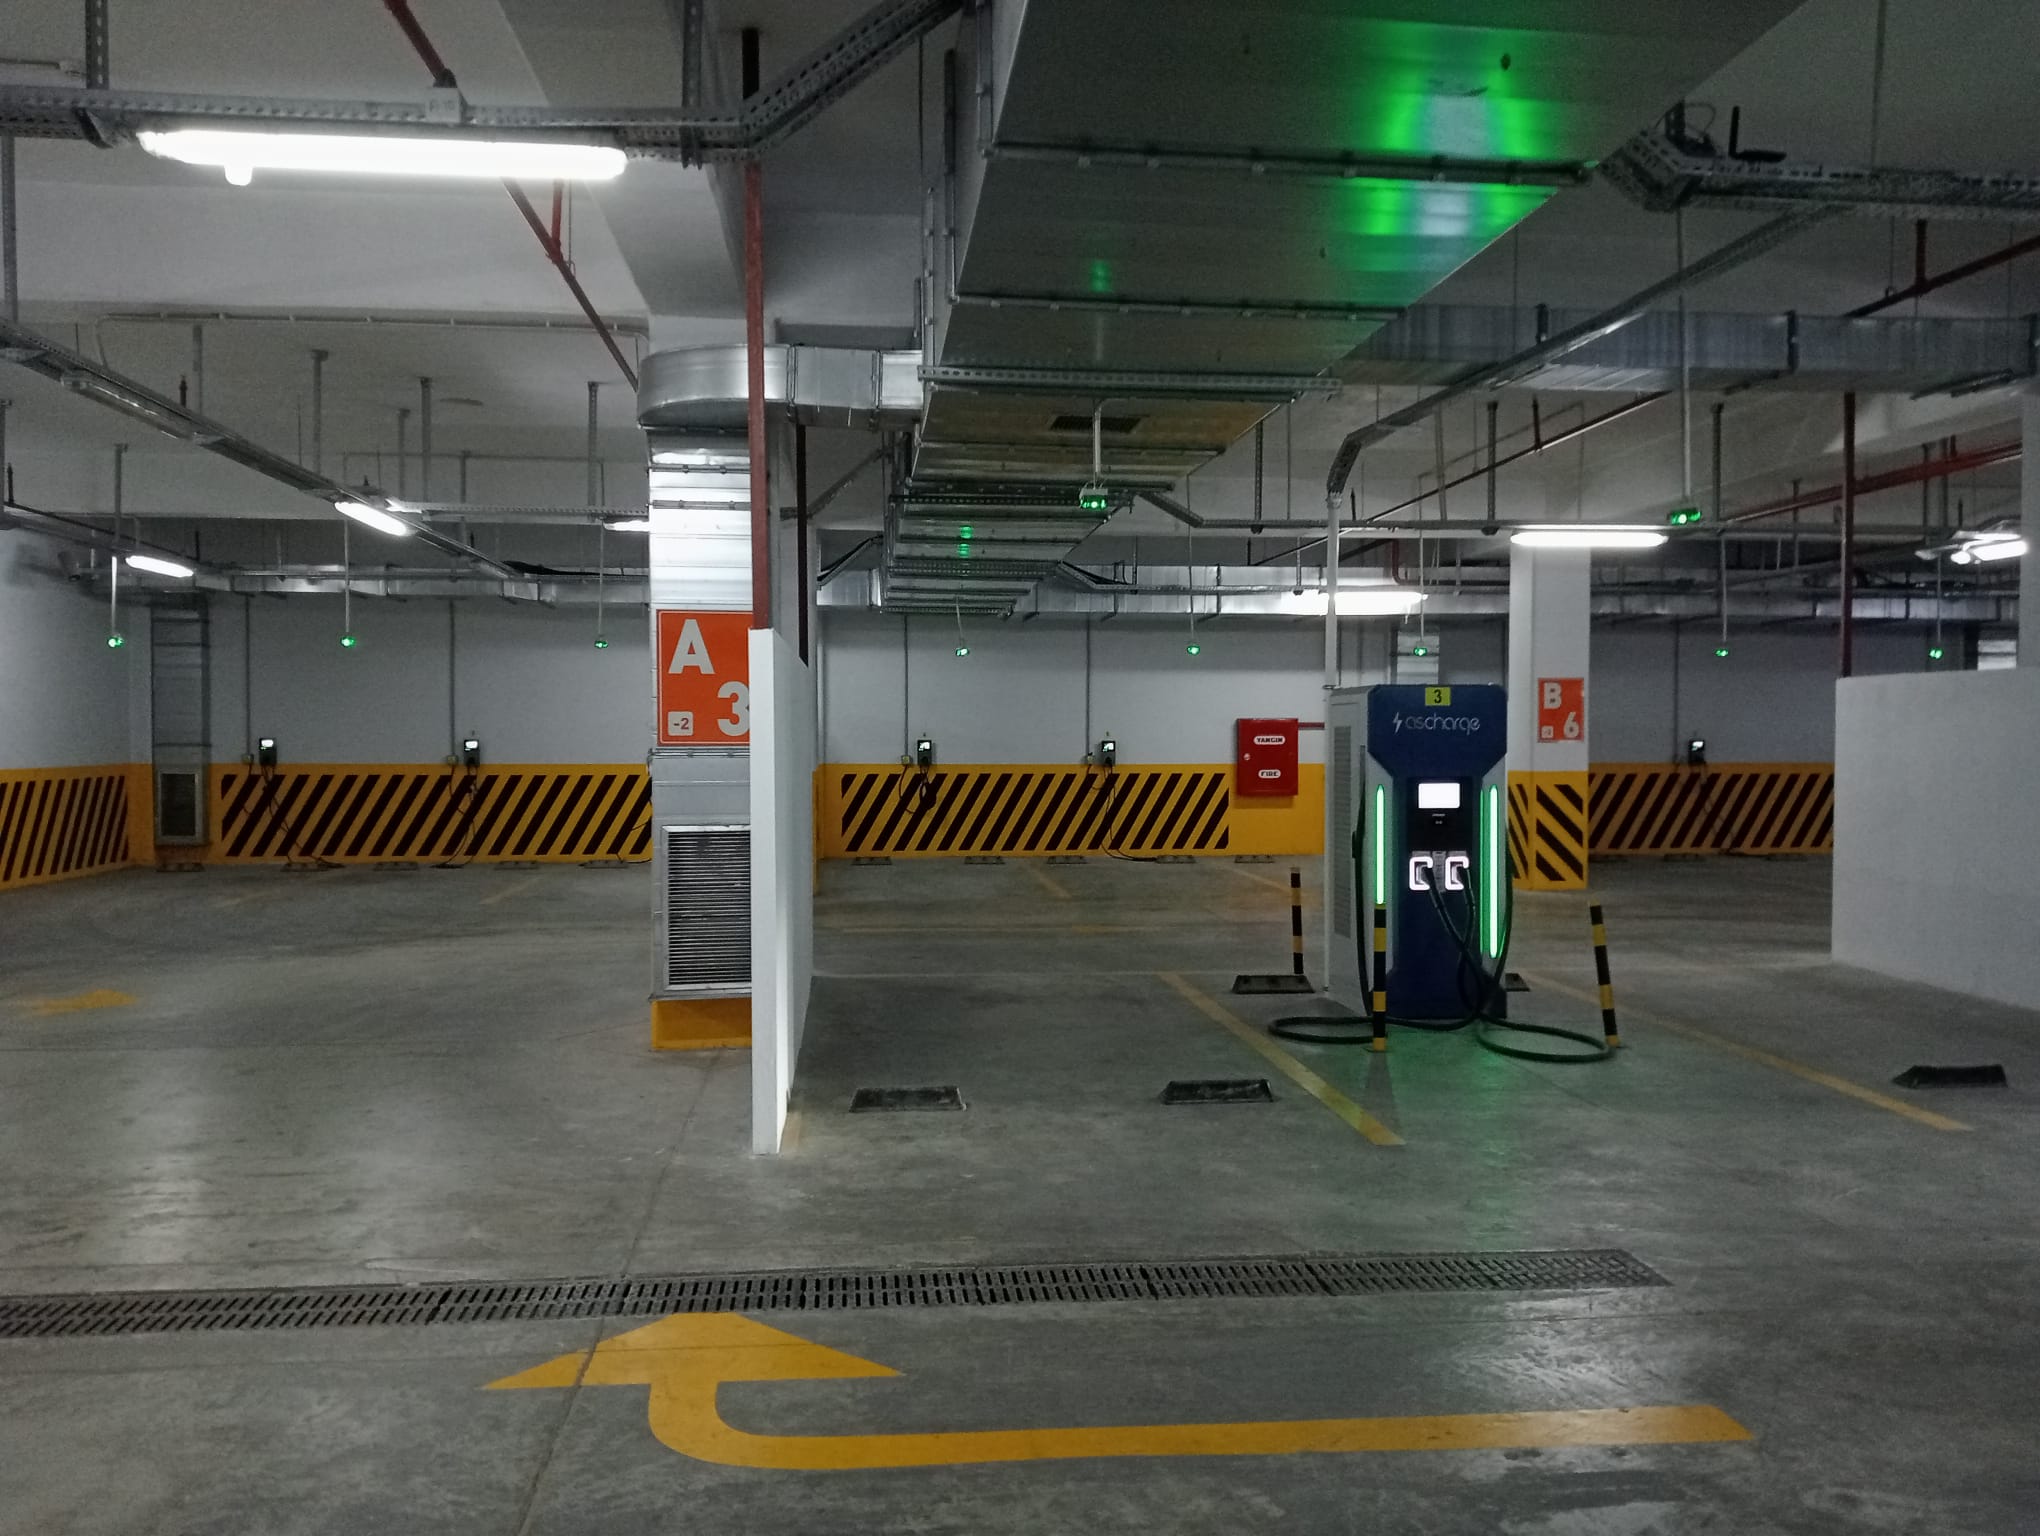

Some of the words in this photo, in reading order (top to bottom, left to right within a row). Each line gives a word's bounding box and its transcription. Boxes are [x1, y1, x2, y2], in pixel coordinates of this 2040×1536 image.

[668, 618, 716, 674] A
[717, 681, 750, 737] 3
[1433, 689, 1443, 704] 3
[1543, 682, 1562, 710] B
[673, 717, 690, 730] -2
[1405, 712, 1481, 736] ascharge
[1563, 711, 1580, 738] 6
